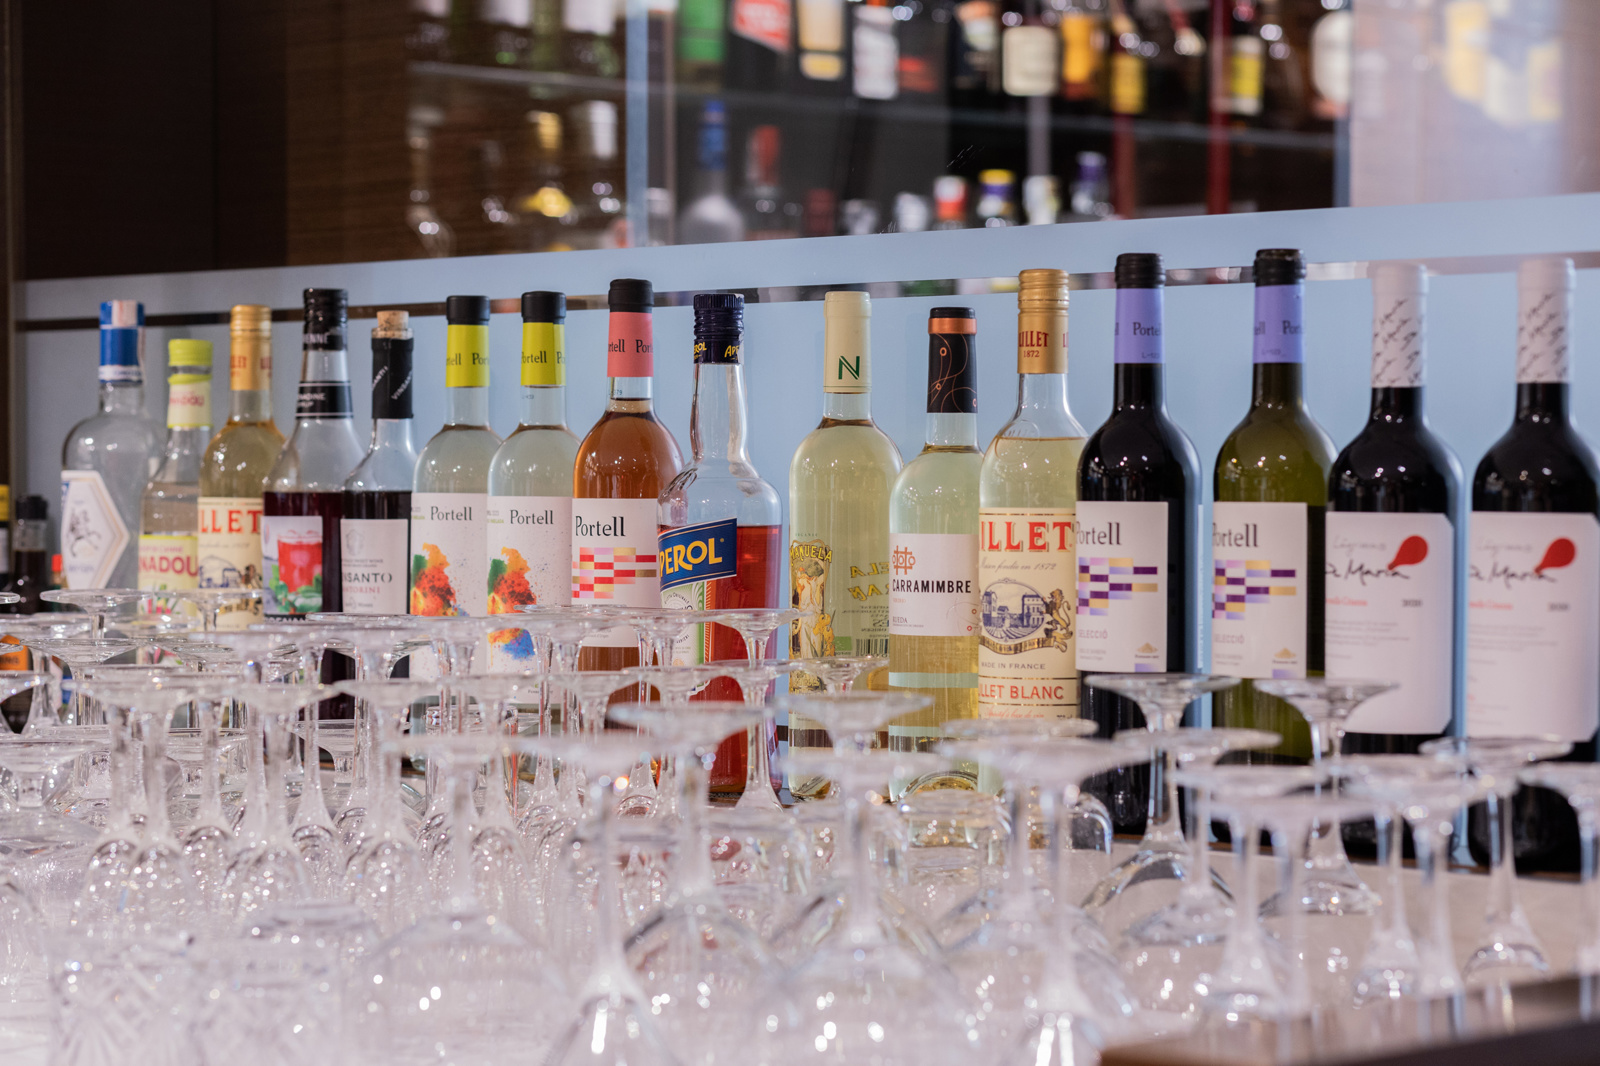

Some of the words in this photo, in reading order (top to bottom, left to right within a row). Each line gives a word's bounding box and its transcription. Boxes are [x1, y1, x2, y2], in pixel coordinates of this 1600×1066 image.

[1024, 350, 1040, 358] 1872
[838, 355, 861, 380] N
[430, 506, 473, 521] Portell
[510, 509, 554, 525] Portell
[575, 515, 626, 537] Portell
[790, 545, 832, 563] MANUELA
[893, 579, 971, 594] CARRAMIMBRE
[1010, 685, 1065, 700] BLANC
